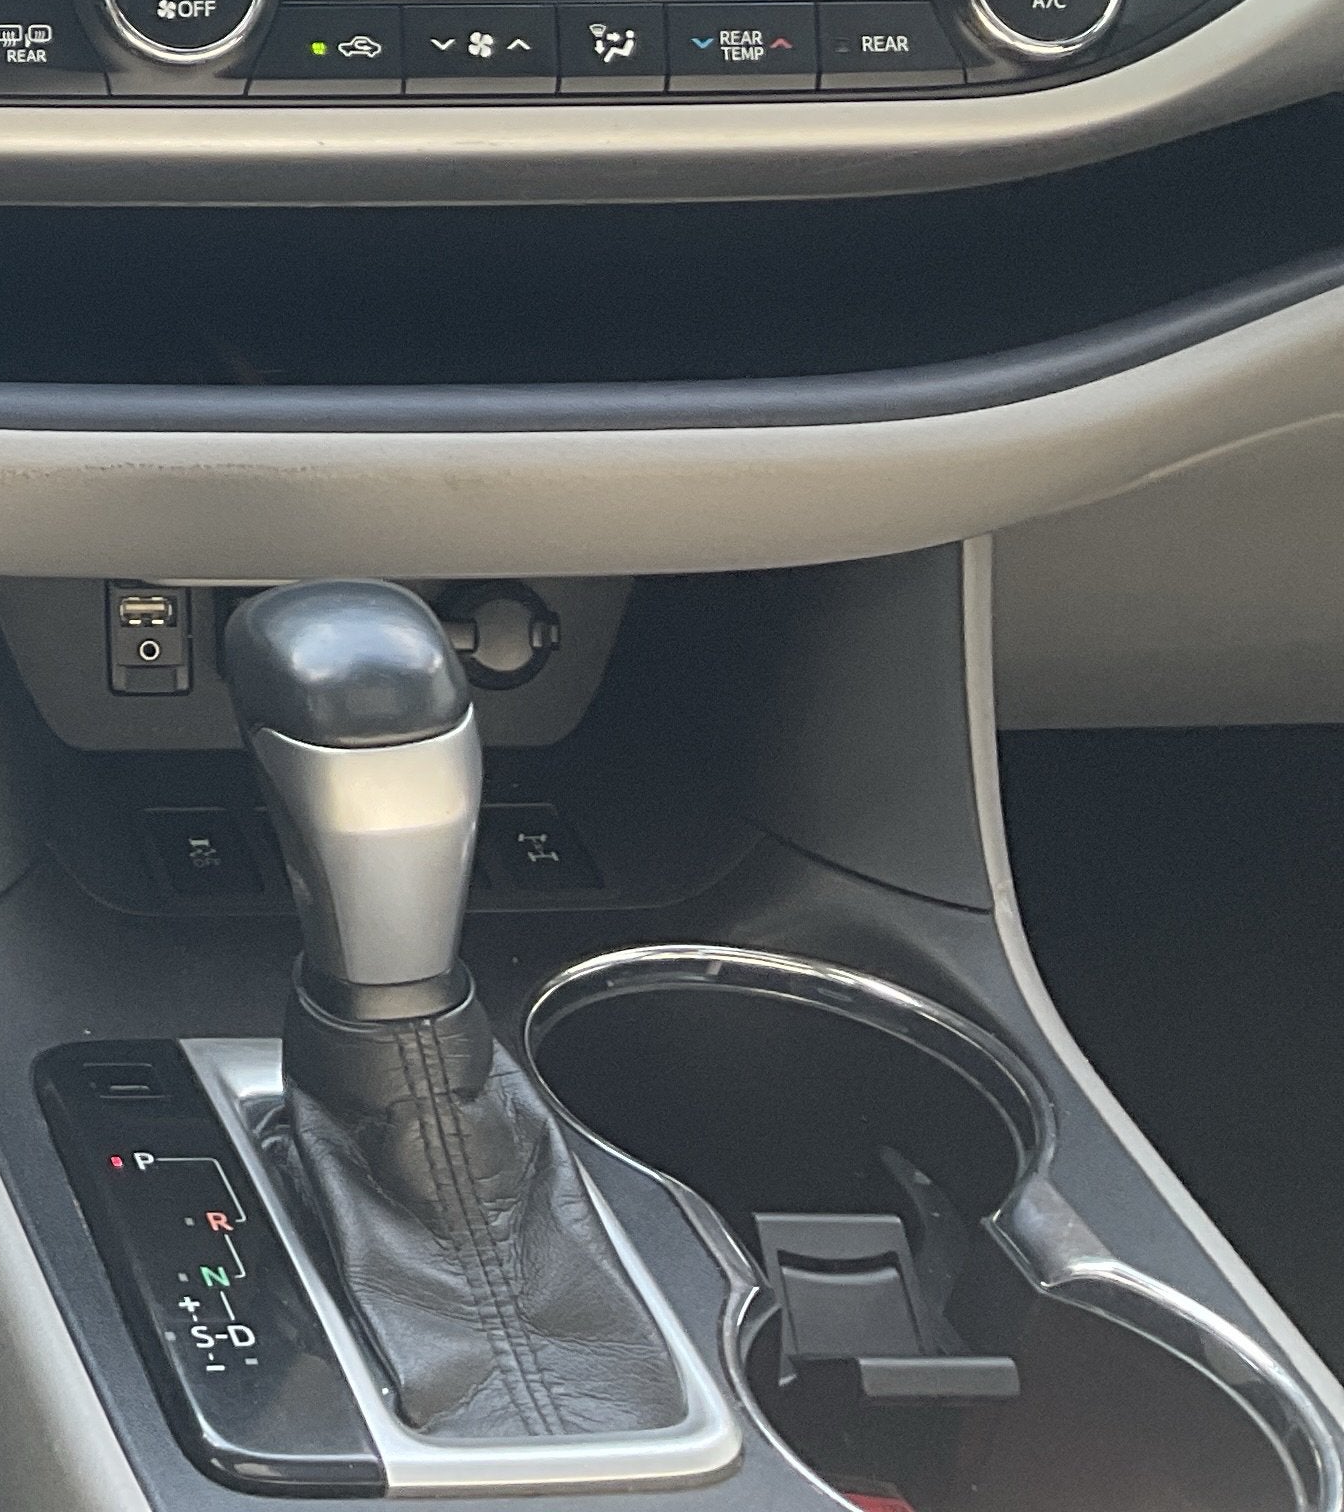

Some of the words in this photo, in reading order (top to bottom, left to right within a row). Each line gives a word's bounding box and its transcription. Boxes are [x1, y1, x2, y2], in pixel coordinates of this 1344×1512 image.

[177, 0, 217, 19] OFF
[719, 30, 763, 46] REAR
[861, 35, 909, 53] REAR
[6, 48, 47, 64] REAR
[720, 45, 765, 62] TEMP
[133, 1151, 155, 1170] P
[205, 1211, 234, 1231] R
[200, 1266, 230, 1287] N
